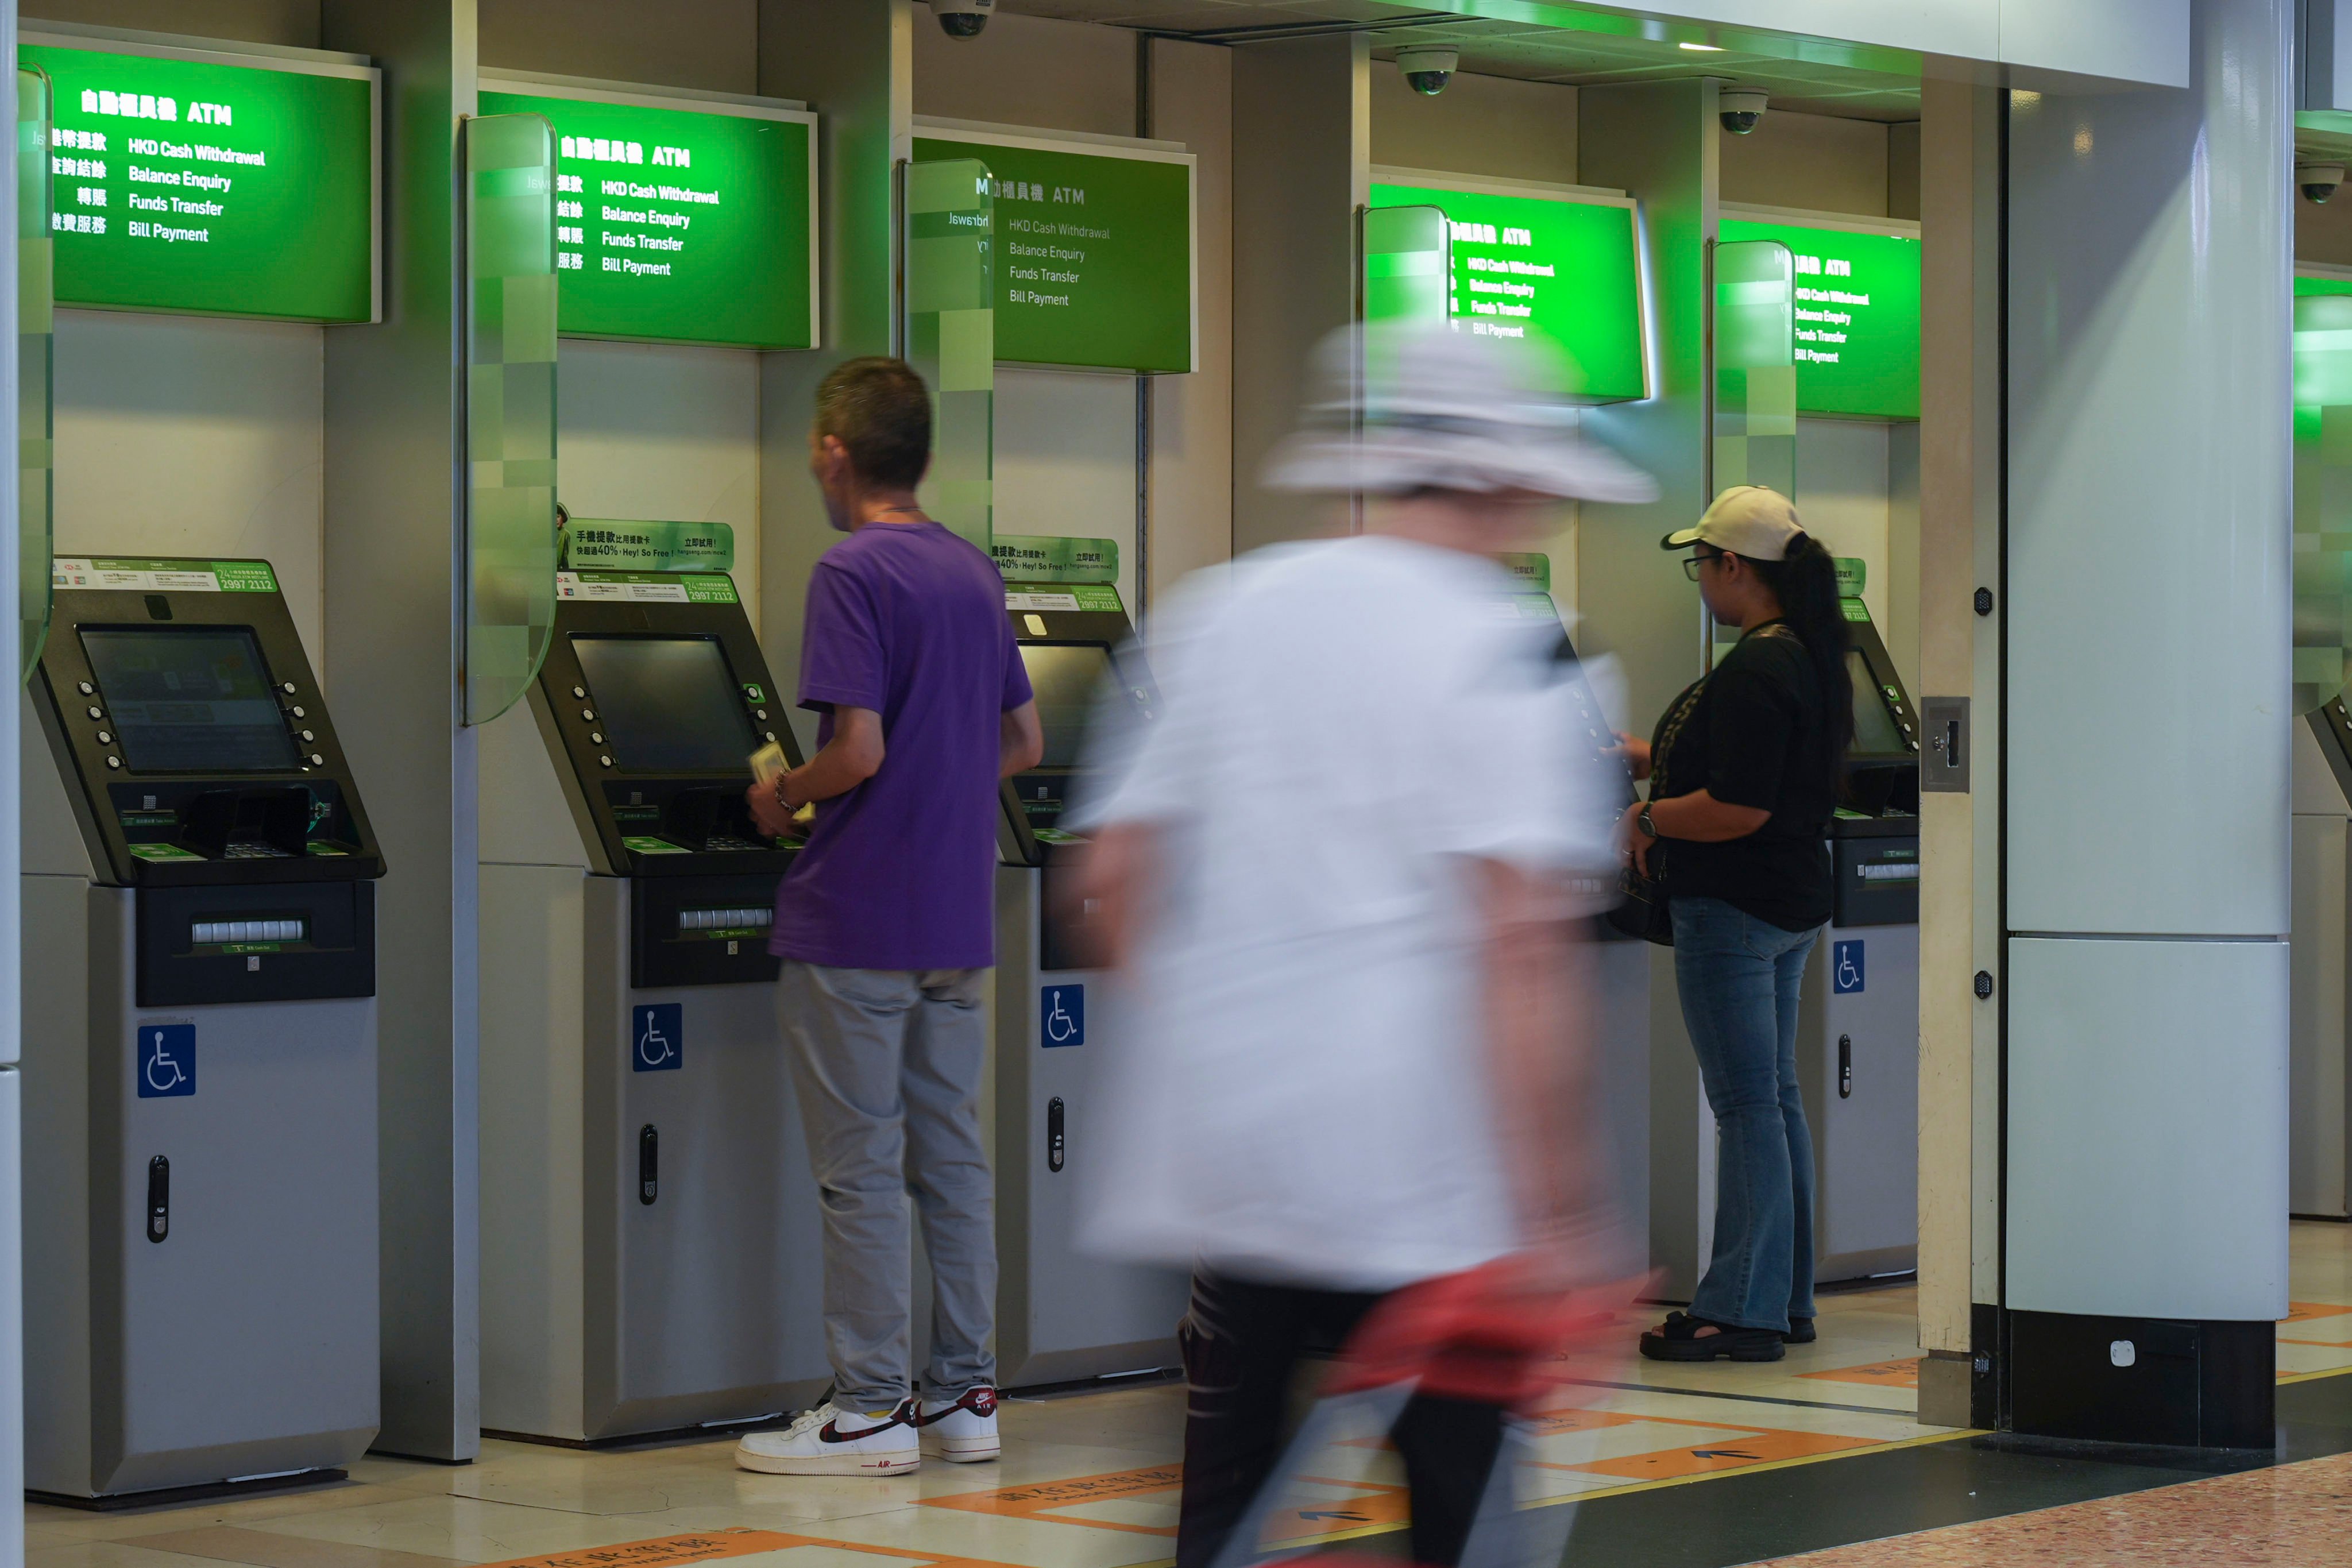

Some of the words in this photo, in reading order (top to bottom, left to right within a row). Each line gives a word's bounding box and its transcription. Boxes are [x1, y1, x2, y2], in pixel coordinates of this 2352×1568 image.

[187, 102, 231, 126] ATM
[129, 138, 158, 155] HKD
[160, 141, 192, 159] Cash
[194, 144, 265, 166] Withdrawal
[651, 146, 690, 168] ATM
[129, 165, 180, 185] Balance
[183, 171, 231, 192] Enquiry
[601, 180, 627, 196] HKD
[629, 183, 656, 199] Cash
[658, 185, 720, 204] Withdrawal
[1053, 187, 1085, 204] ATM
[129, 193, 168, 211] Funds
[170, 197, 224, 216] Transfer
[602, 206, 646, 223] Balance
[648, 210, 690, 230] Enquiry
[129, 221, 150, 237] Bill
[153, 223, 208, 242] Payment
[1010, 219, 1030, 231] HKD
[1033, 221, 1056, 234] Cash
[1059, 223, 1110, 239] Withdrawal
[1503, 227, 1531, 246] ATM
[603, 231, 636, 248] Funds
[638, 234, 683, 251] Transfer
[1010, 242, 1047, 257] Balance
[1050, 246, 1085, 262] Enquiry
[603, 257, 621, 272] Bill
[623, 258, 671, 276] Payment
[1010, 266, 1038, 280] Funds
[1041, 268, 1080, 283] Transfer
[1467, 257, 1487, 271] HKD
[1488, 258, 1509, 273] Cash
[1509, 261, 1555, 277] Withdrawal
[1825, 259, 1851, 276] ATM
[1010, 289, 1025, 303] Bill
[1028, 291, 1069, 307] Payment
[1469, 279, 1503, 293] Balance
[1503, 281, 1535, 299] Enquiry
[1811, 289, 1829, 302] Cash
[1829, 290, 1870, 305] Withdrawal
[1471, 300, 1497, 314] Funds
[1497, 302, 1531, 317] Transfer
[1795, 308, 1823, 321] Balance
[1824, 310, 1851, 326] Enquiry
[1473, 322, 1487, 335] Bill
[1488, 323, 1524, 338] Payment
[1817, 330, 1847, 343] Transfer
[1795, 349, 1807, 361] Bill
[1808, 349, 1839, 364] Payment
[641, 549, 651, 557] So
[221, 580, 245, 589] 2997
[248, 580, 272, 589] 2112
[689, 592, 710, 600] 2997
[712, 592, 734, 600] 2112
